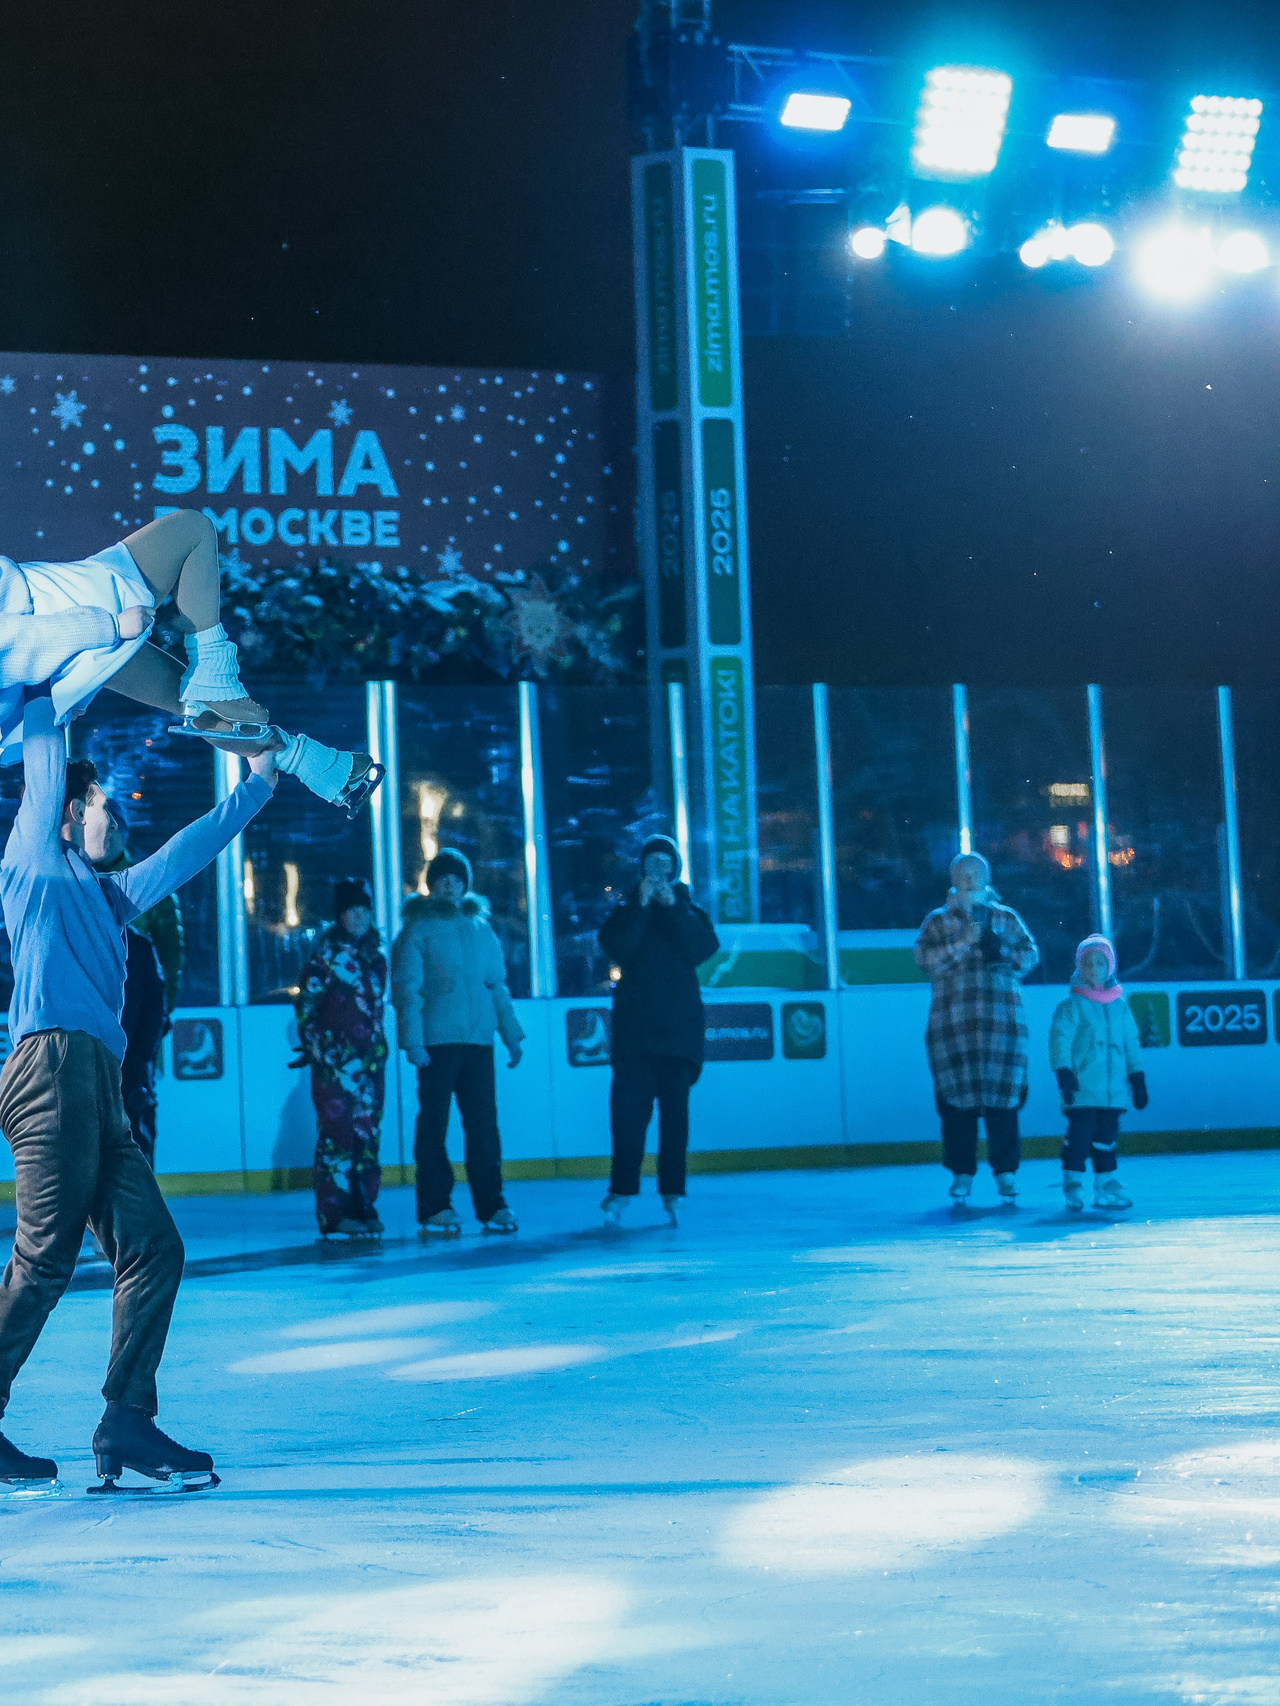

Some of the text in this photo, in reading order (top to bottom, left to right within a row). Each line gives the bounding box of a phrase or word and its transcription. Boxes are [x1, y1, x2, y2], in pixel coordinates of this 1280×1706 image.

[702, 193, 724, 374] zima.mos.ru
[152, 423, 400, 498] ЗИМА
[202, 507, 400, 547] МОСКВЕ
[710, 487, 733, 576] 2025
[1185, 1004, 1260, 1032] 2025
